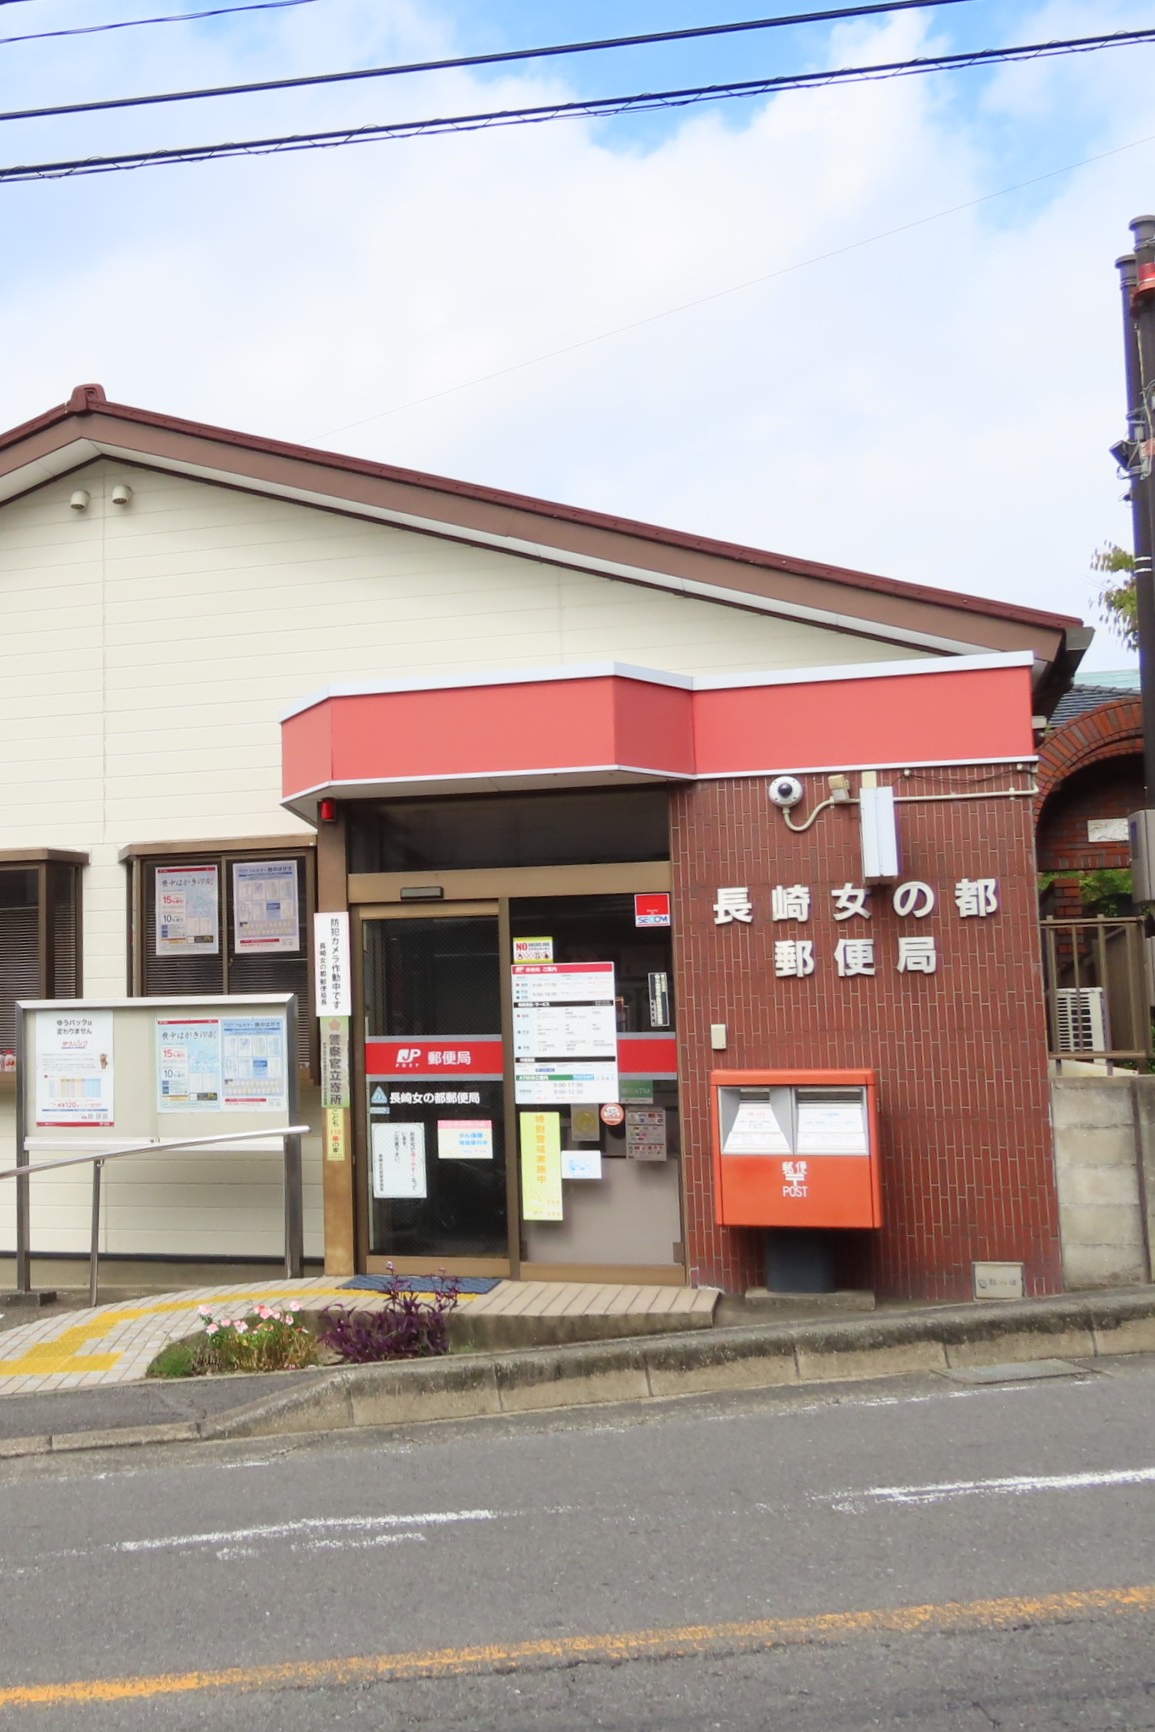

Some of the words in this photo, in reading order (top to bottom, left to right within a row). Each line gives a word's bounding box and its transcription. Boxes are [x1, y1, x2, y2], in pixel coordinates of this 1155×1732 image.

[713, 878, 997, 925] 長崎女の都
[516, 943, 528, 951] NO
[774, 936, 936, 977] 郵便局
[319, 942, 327, 1005] 長崎女の都郵便局長
[330, 918, 341, 1009] 防犯カメラ作動中です
[329, 1034, 342, 1105] 警察官立寄所
[428, 1051, 471, 1065] 郵便局
[389, 1092, 481, 1104] 長崎女の都郵便局
[782, 1161, 807, 1175] 郵便
[782, 1186, 808, 1198] POST
